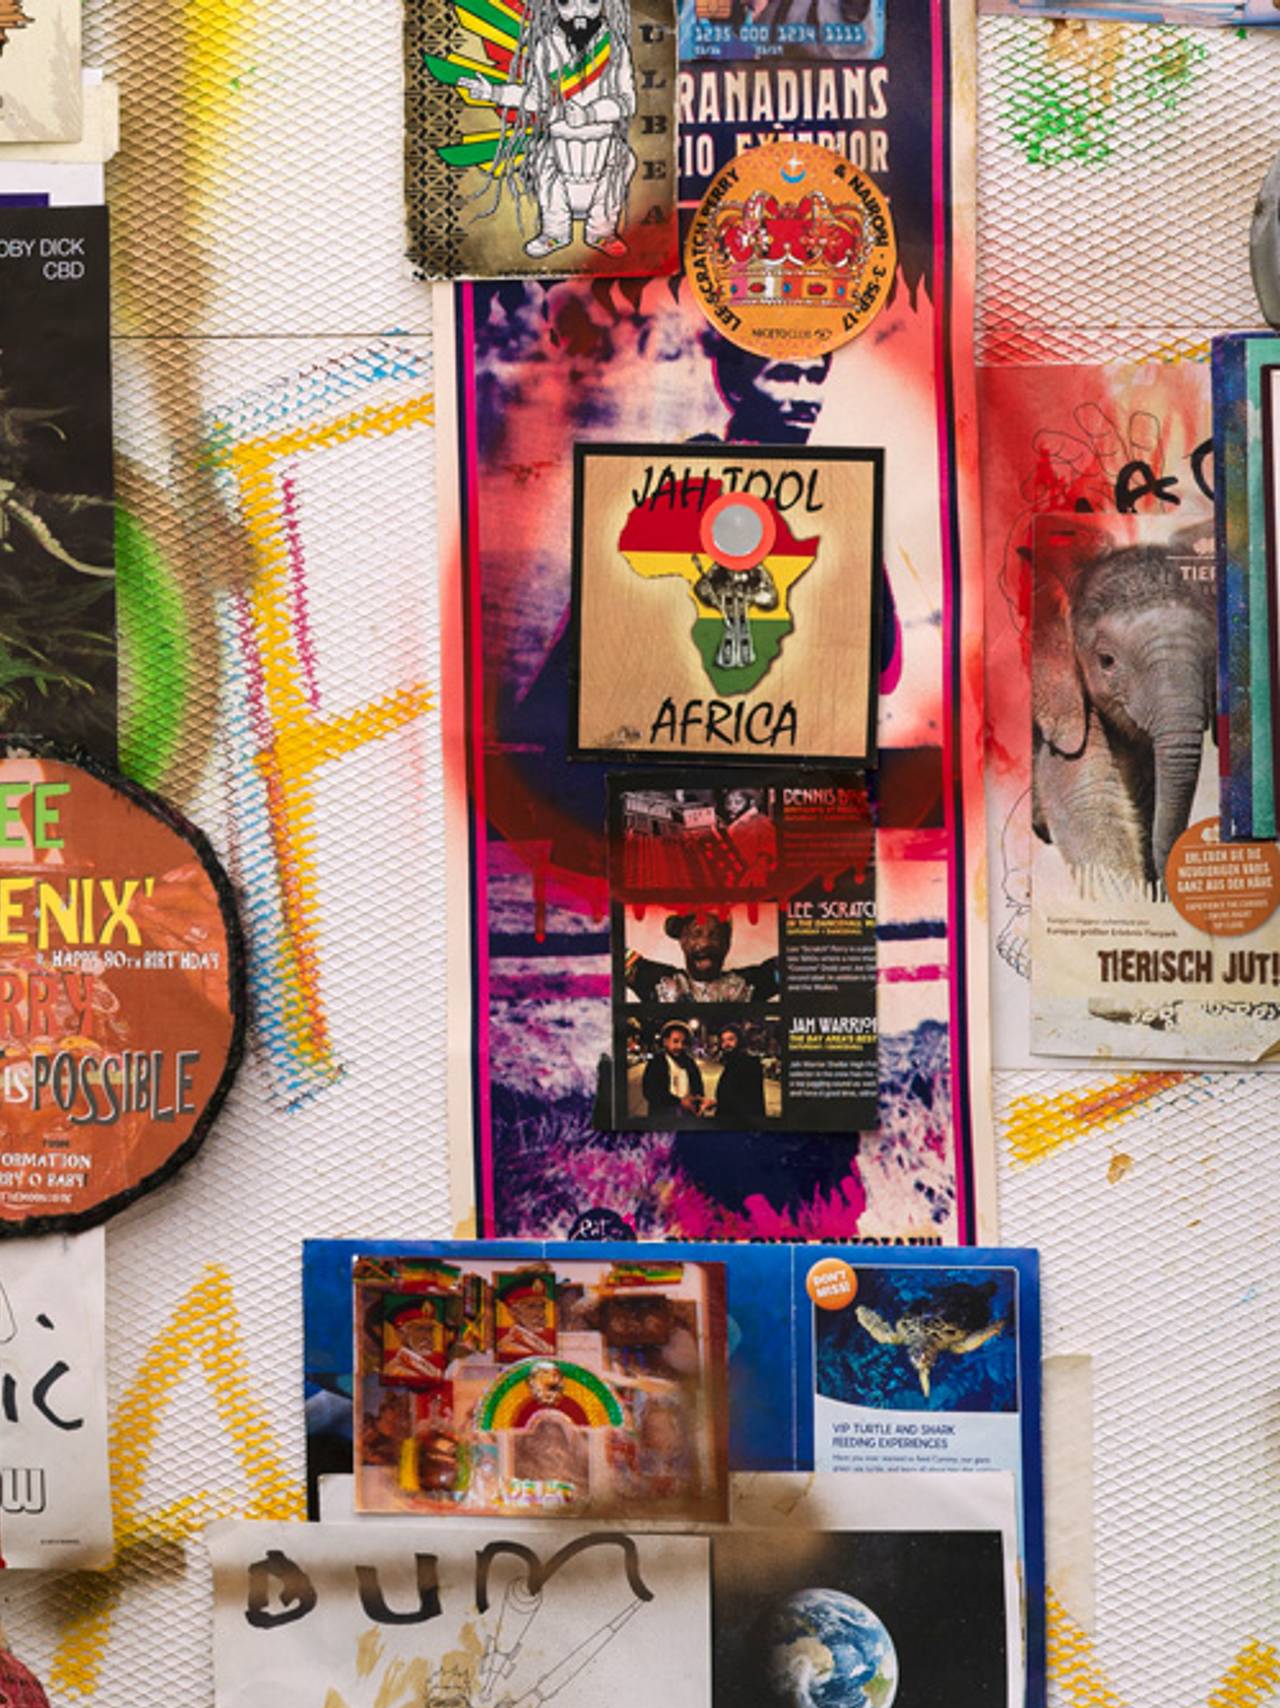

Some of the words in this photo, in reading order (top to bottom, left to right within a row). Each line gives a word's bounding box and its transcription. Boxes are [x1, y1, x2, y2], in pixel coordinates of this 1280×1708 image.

[777, 26, 817, 42] 1234
[40, 237, 84, 257] DICK
[43, 260, 85, 280] CBD
[632, 465, 709, 512] JAH
[649, 696, 799, 748] AFRICA
[783, 788, 836, 805] DENNIS
[1177, 881, 1203, 893] GANZ
[1206, 880, 1225, 891] AUS
[1227, 879, 1245, 890] DER
[1098, 950, 1213, 983] TIERISCH
[1222, 950, 1280, 986] JUT!
[3, 1062, 30, 1102] IS
[31, 1049, 200, 1125] POSSIBLE
[812, 1270, 848, 1287] DON'T
[832, 1423, 851, 1435] VIP
[854, 1423, 892, 1436] TURTLE
[895, 1424, 918, 1436] AND
[921, 1424, 955, 1436] SHARK
[832, 1437, 876, 1449] FEEDING
[879, 1438, 948, 1449] EXPERIENCES
